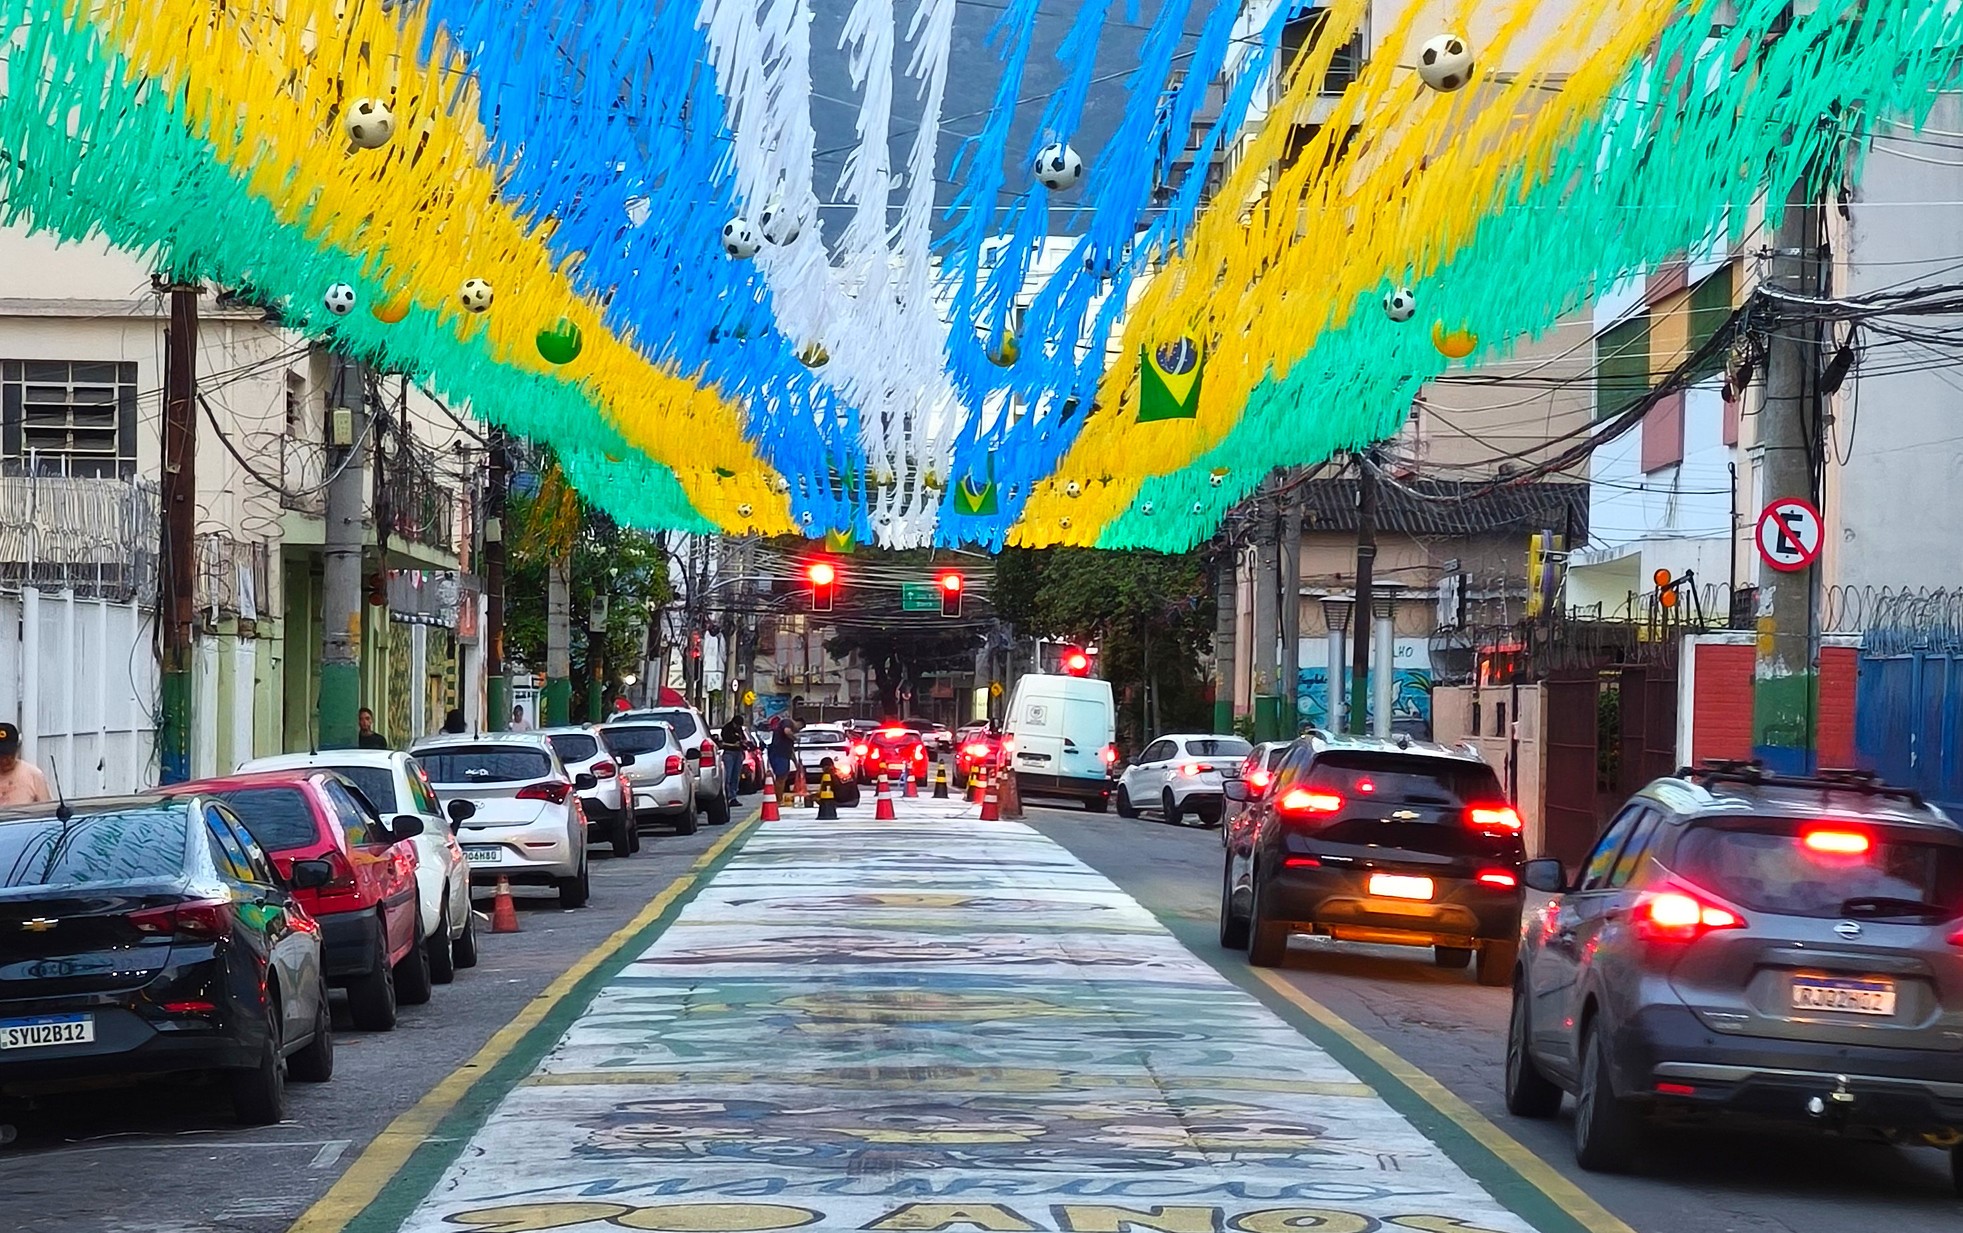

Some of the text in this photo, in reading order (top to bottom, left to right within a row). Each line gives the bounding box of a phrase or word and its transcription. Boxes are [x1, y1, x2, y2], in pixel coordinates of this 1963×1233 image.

[1776, 513, 1803, 555] E
[9, 1023, 85, 1046] SYU2B12
[441, 1201, 827, 1233] 90
